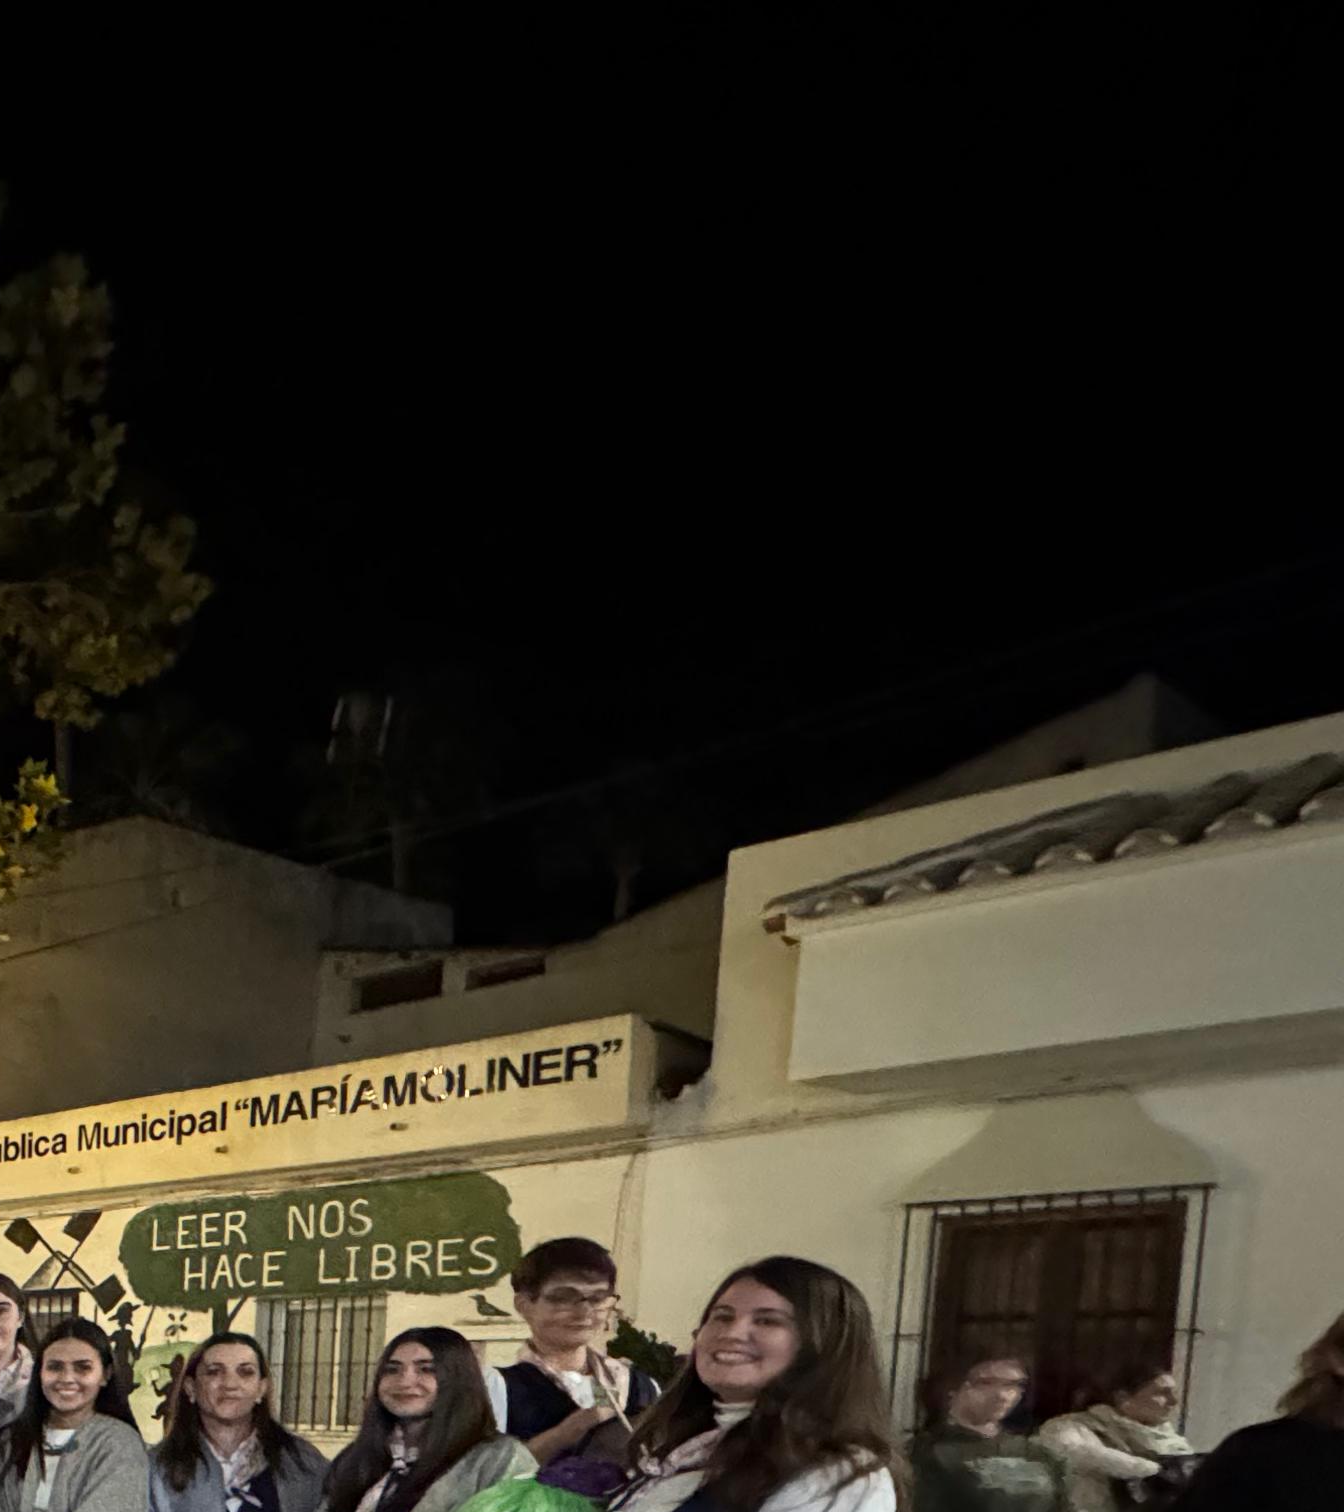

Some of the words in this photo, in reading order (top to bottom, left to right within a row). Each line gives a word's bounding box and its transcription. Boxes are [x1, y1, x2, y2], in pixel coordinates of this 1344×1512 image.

[78, 1101, 228, 1152] Municipal
[151, 1209, 248, 1252] LEER
[287, 1198, 374, 1241] NOS
[183, 1250, 287, 1292] HACE
[317, 1236, 499, 1285] LIBRES
